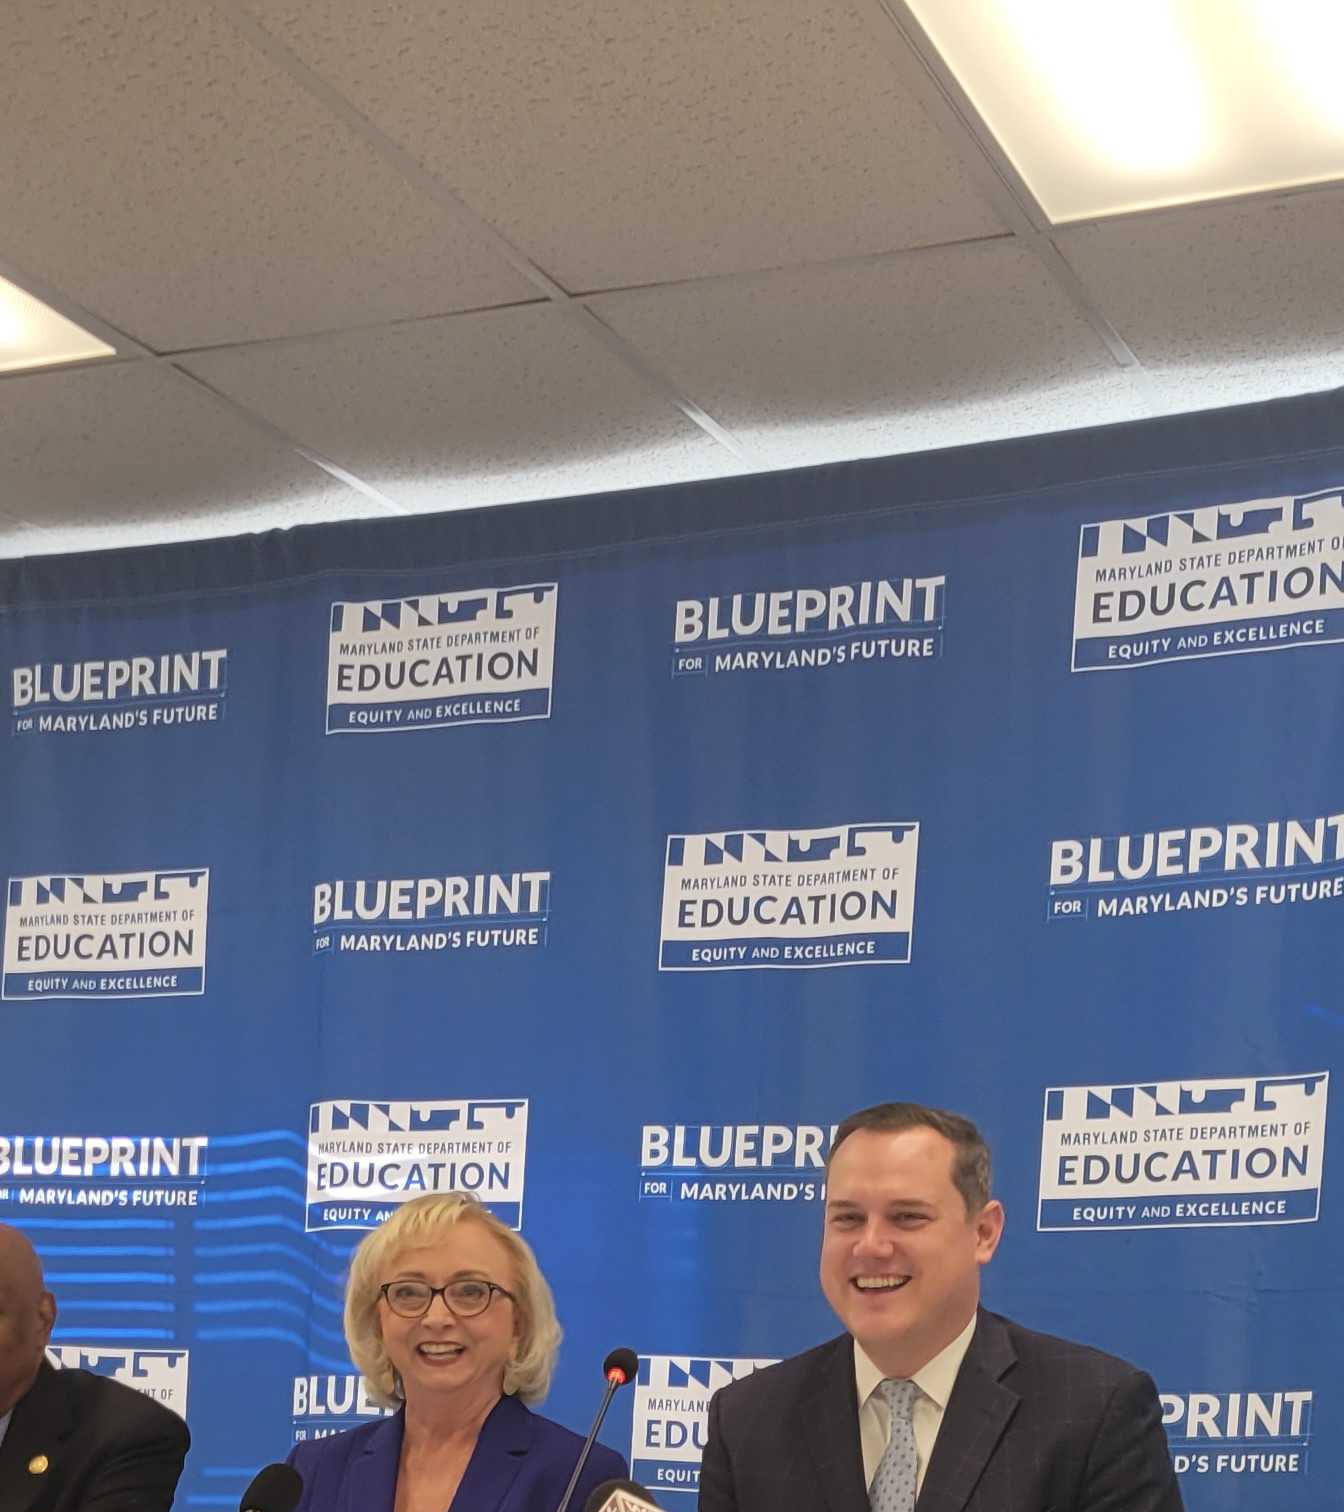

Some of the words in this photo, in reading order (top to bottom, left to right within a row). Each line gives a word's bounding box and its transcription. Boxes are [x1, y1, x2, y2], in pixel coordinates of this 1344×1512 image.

[1096, 560, 1172, 582] MARYLAND
[1179, 554, 1221, 571] STATE
[1228, 539, 1324, 565] DEPARTMENT
[675, 576, 945, 642] BLUEPRINT
[340, 641, 403, 656] MARYLAND
[408, 636, 441, 651] STATE
[447, 629, 520, 648] DEPARTMENT
[526, 626, 539, 640] OF
[1109, 638, 1171, 659] EQUITY
[1177, 636, 1208, 649] AND
[1214, 620, 1324, 645] EXCELLENCE
[679, 658, 702, 670] FOR
[716, 646, 845, 672] MARYLAND'S
[851, 638, 933, 660] FUTURE
[14, 649, 226, 706] BLUEPRINT
[338, 648, 538, 691] EDUCATION
[18, 718, 32, 730] FOR
[40, 710, 147, 731] MARYLAND'S
[153, 704, 217, 724] FUTURE
[349, 709, 402, 724] EQUITY
[407, 708, 432, 720] AND
[436, 699, 520, 717] EXCELLENCE
[681, 875, 746, 890] MARYLAND
[753, 874, 792, 886] STATE
[798, 868, 876, 887] DEPARTMENT
[882, 868, 898, 880] OF
[314, 872, 550, 924] BLUEPRINT
[678, 890, 897, 928] EDUCATION
[1054, 901, 1081, 914] FOR
[1098, 887, 1248, 916] MARYLAND'S
[1256, 877, 1344, 904] FUTURE
[20, 914, 68, 928] MARYLAND
[73, 914, 106, 925] STATE
[111, 910, 177, 925] DEPARTMENT
[182, 909, 194, 921] OF
[18, 930, 193, 961] EDUCATION
[316, 936, 329, 950] FOR
[341, 932, 460, 950] MARYLAND'S
[467, 928, 538, 947] FUTURE
[692, 947, 746, 962] EQUITY
[752, 948, 779, 958] AND
[784, 942, 875, 958] EXCELLENCE
[28, 978, 68, 992] EQUITY
[72, 979, 96, 990] AND
[100, 976, 177, 990] EXCELLENCE
[642, 1125, 838, 1167] BLUEPR
[1061, 1131, 1137, 1146] MARYLAND
[1144, 1128, 1184, 1142] STATE
[1190, 1124, 1288, 1140] DEPARTMENT
[1294, 1121, 1310, 1135] OF
[378, 1142, 413, 1154] STATE
[419, 1142, 492, 1154] DEPARTMENT
[498, 1142, 511, 1153] OF
[1058, 1145, 1308, 1185] EDUCATION
[19, 1188, 128, 1206] MARYLAND'S
[132, 1190, 197, 1206] FUTURE
[645, 1182, 666, 1193] FOR
[681, 1183, 814, 1200] MARYLAND'S
[324, 1208, 371, 1222] EQUITY
[376, 1209, 395, 1221] AN
[1074, 1206, 1136, 1222] EQUITY
[1141, 1206, 1170, 1218] AND
[1176, 1200, 1286, 1216] EXCELLENCE
[161, 1389, 172, 1400] OF
[1159, 1391, 1312, 1438] PRINT
[658, 1469, 700, 1482] EQUIT
[1217, 1454, 1298, 1472] FUTURE
